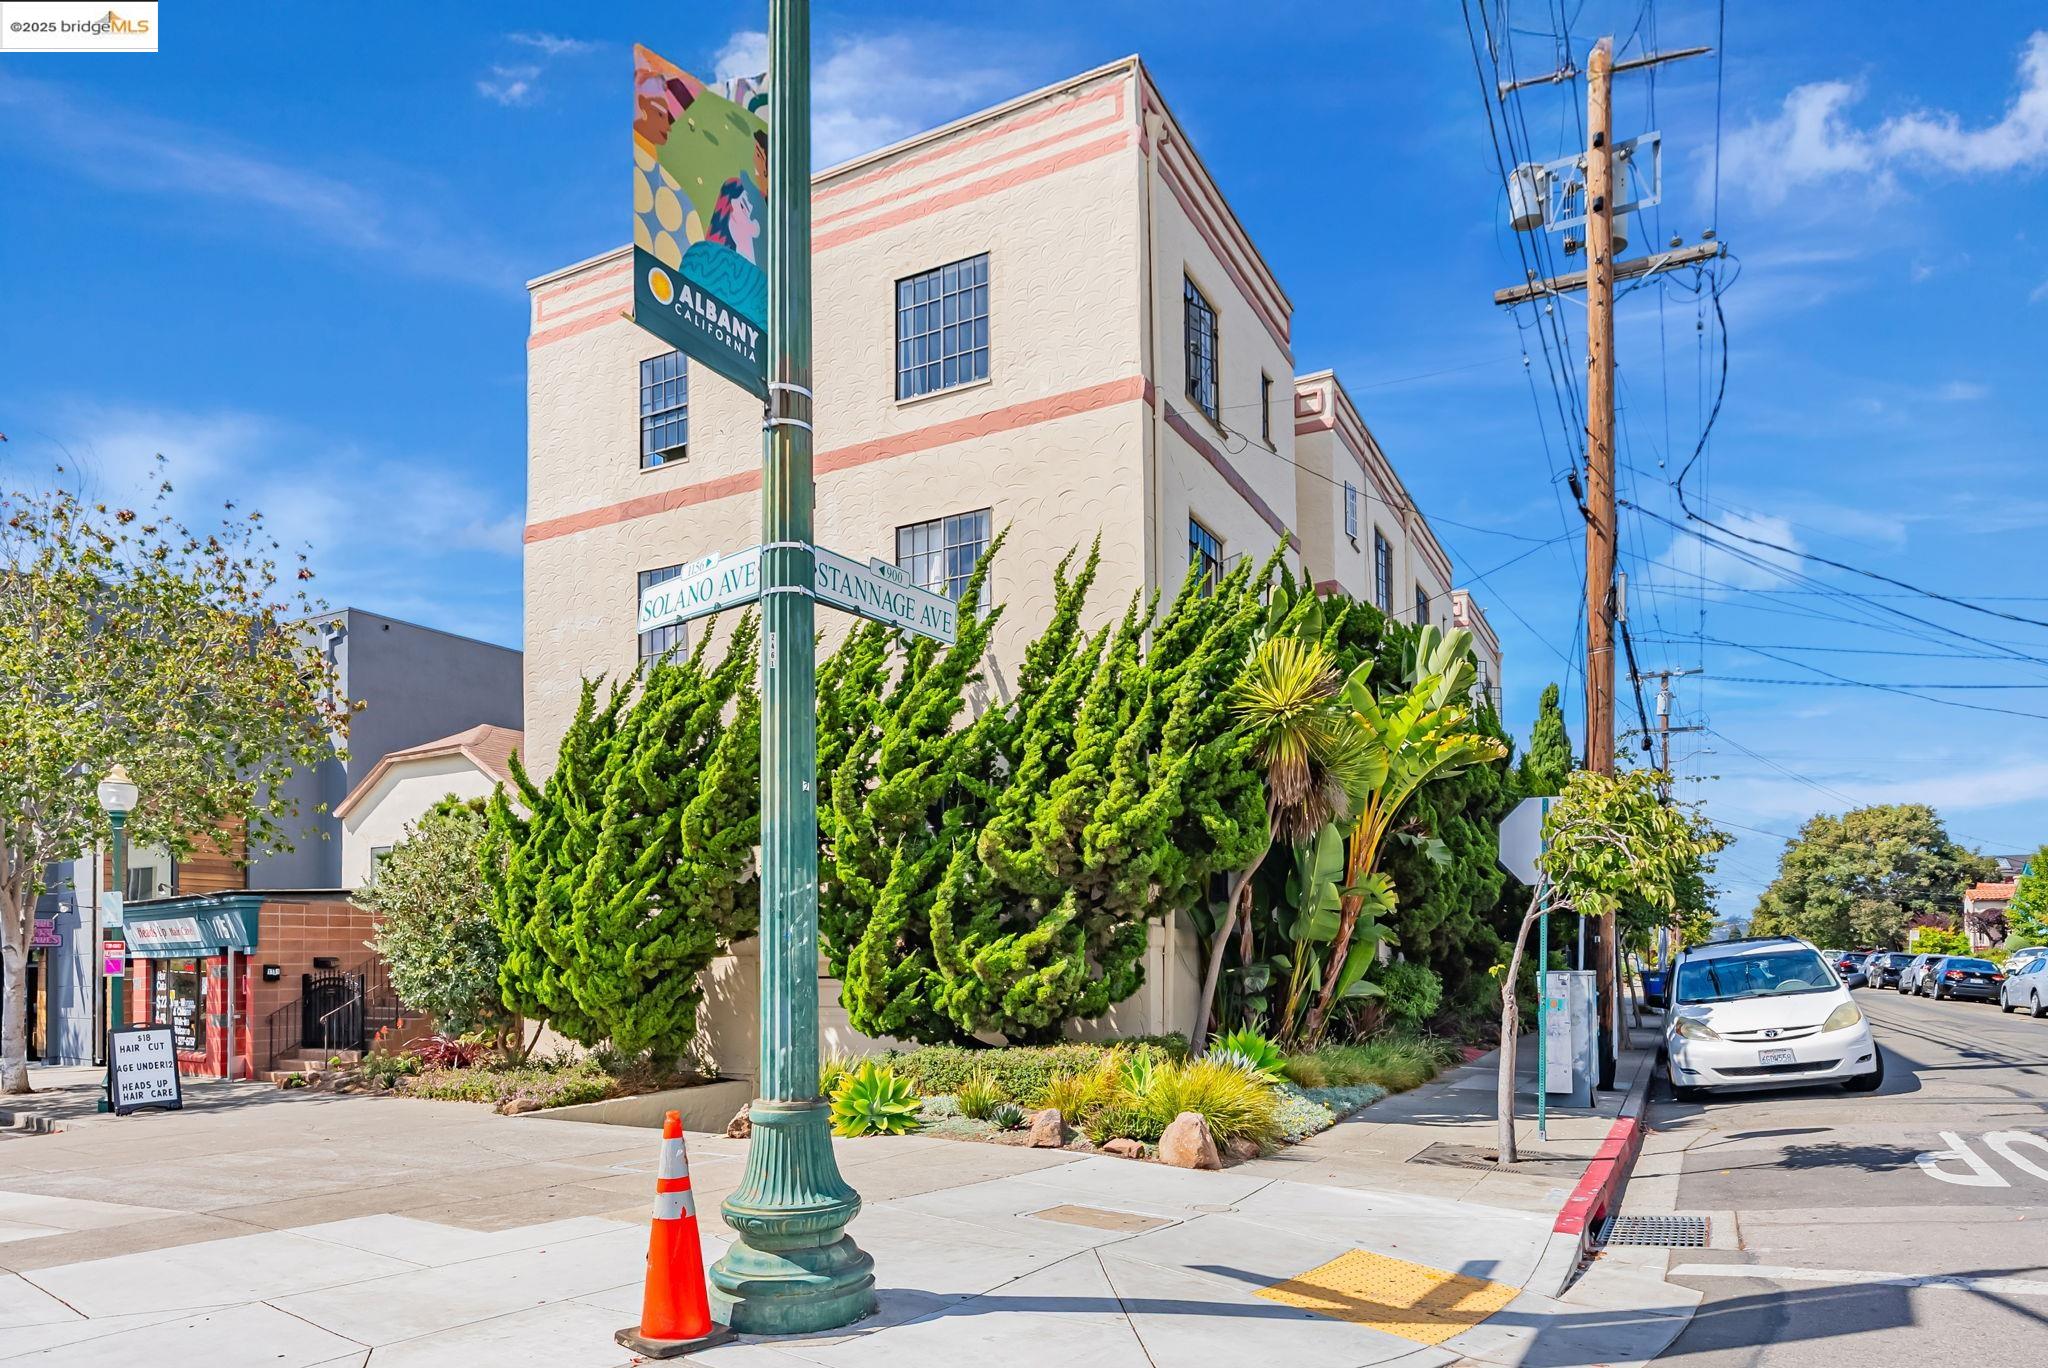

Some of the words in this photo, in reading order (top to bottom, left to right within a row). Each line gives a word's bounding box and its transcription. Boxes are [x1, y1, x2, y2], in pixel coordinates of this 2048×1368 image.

[678, 284, 760, 349] ALBANY
[674, 303, 756, 363] CALIFORNIA
[886, 568, 903, 583] 900
[642, 577, 714, 622] SOLANO
[718, 561, 756, 596] AVE
[818, 562, 916, 621] STANNAGE
[919, 604, 952, 634] AVE
[138, 1034, 151, 1042] $18
[120, 1044, 140, 1053] HAIR
[148, 1042, 165, 1051] CUT
[117, 1064, 134, 1073] AGE
[122, 1081, 152, 1091] HEADS
[156, 1080, 168, 1088] UP
[123, 1092, 144, 1101] HAIR
[151, 1088, 174, 1098] CARE
